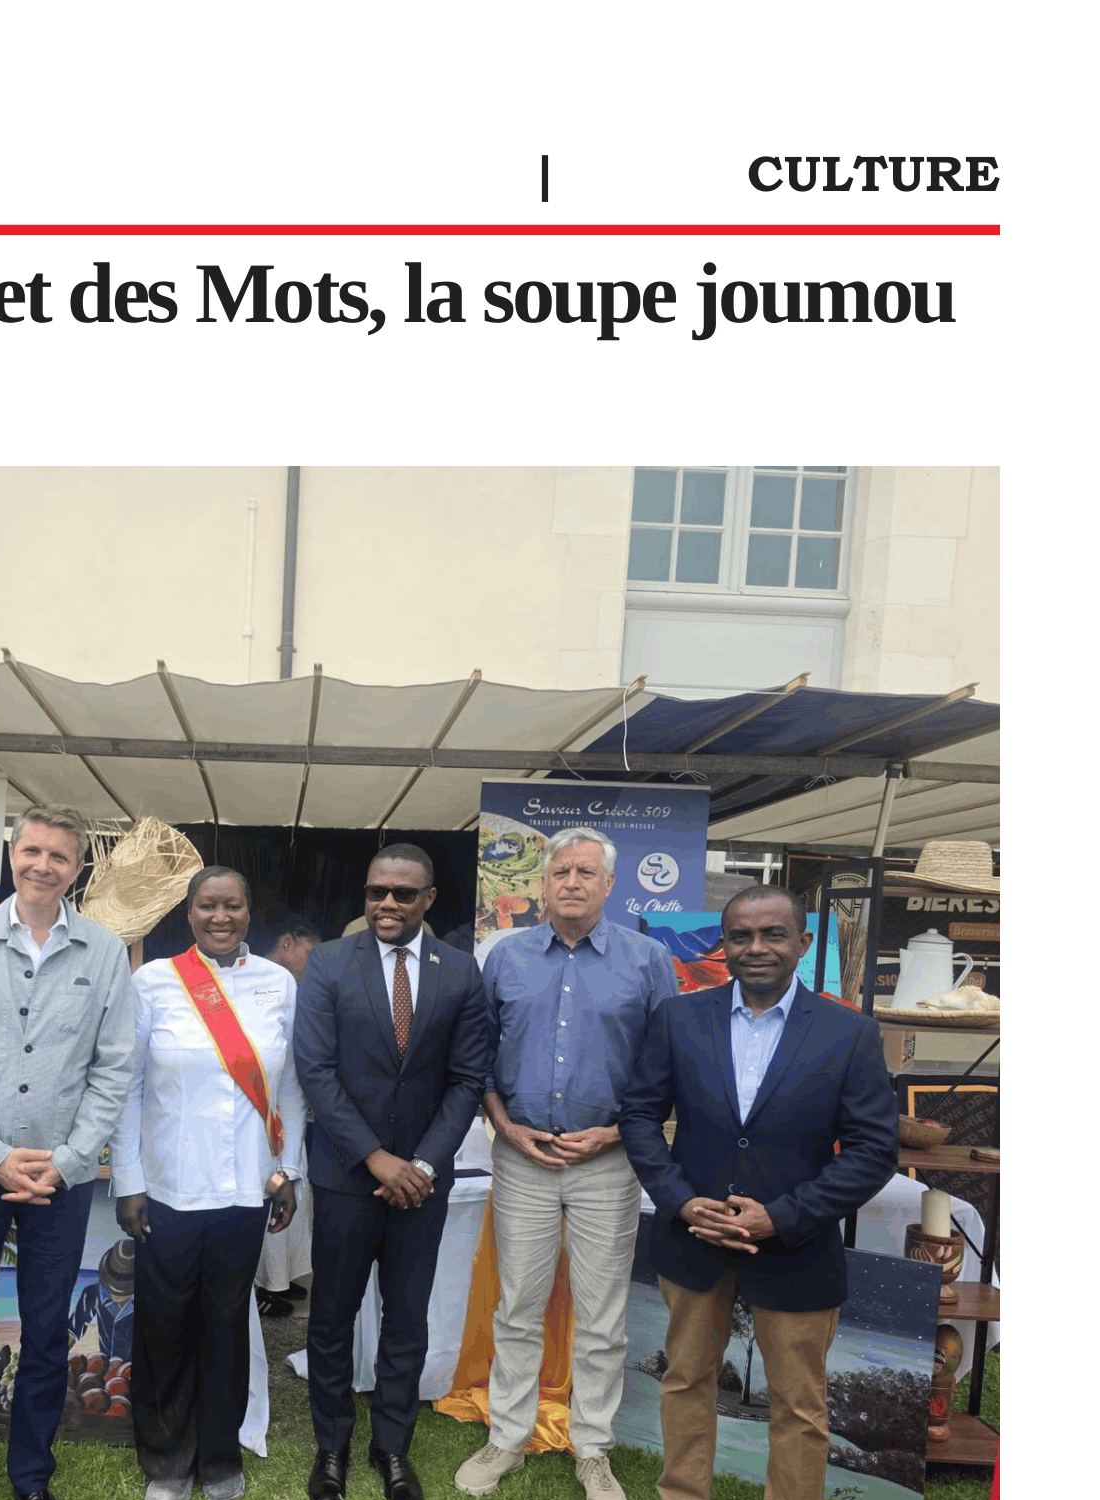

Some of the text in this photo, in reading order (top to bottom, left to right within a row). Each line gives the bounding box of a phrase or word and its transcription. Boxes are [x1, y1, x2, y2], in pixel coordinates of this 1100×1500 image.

[749, 156, 1000, 192] CULTURE
[70, 262, 178, 323] des
[196, 265, 385, 335] Mots,
[405, 262, 466, 323] la
[484, 281, 676, 340] soupe
[692, 262, 956, 340] joumou
[522, 798, 672, 818] Saveur Créole 509
